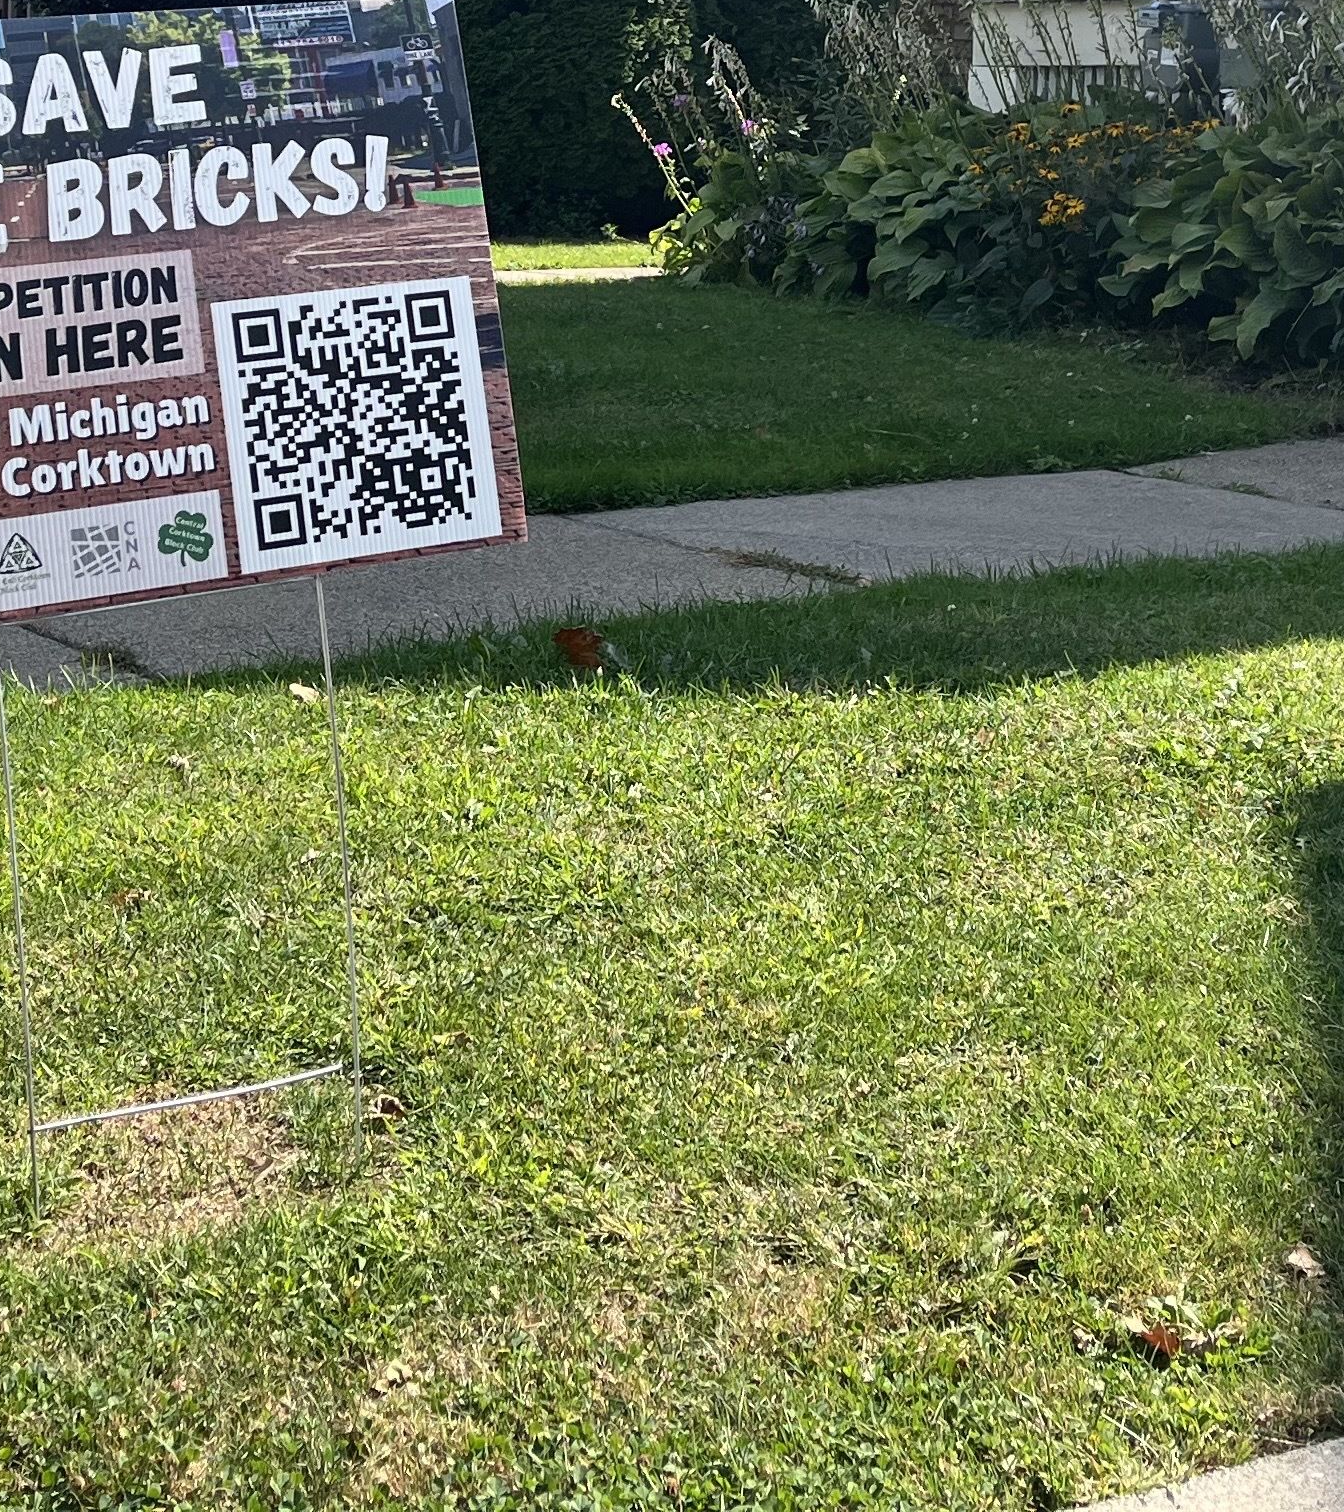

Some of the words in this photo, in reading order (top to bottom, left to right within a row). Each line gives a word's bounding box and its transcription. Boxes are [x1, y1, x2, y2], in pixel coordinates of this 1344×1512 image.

[46, 134, 389, 243] BRICKS!
[45, 314, 184, 377] HERE
[8, 392, 212, 450] Michigan
[1, 441, 215, 497] Corktown
[168, 526, 206, 542] Corktown
[175, 516, 205, 530] Central
